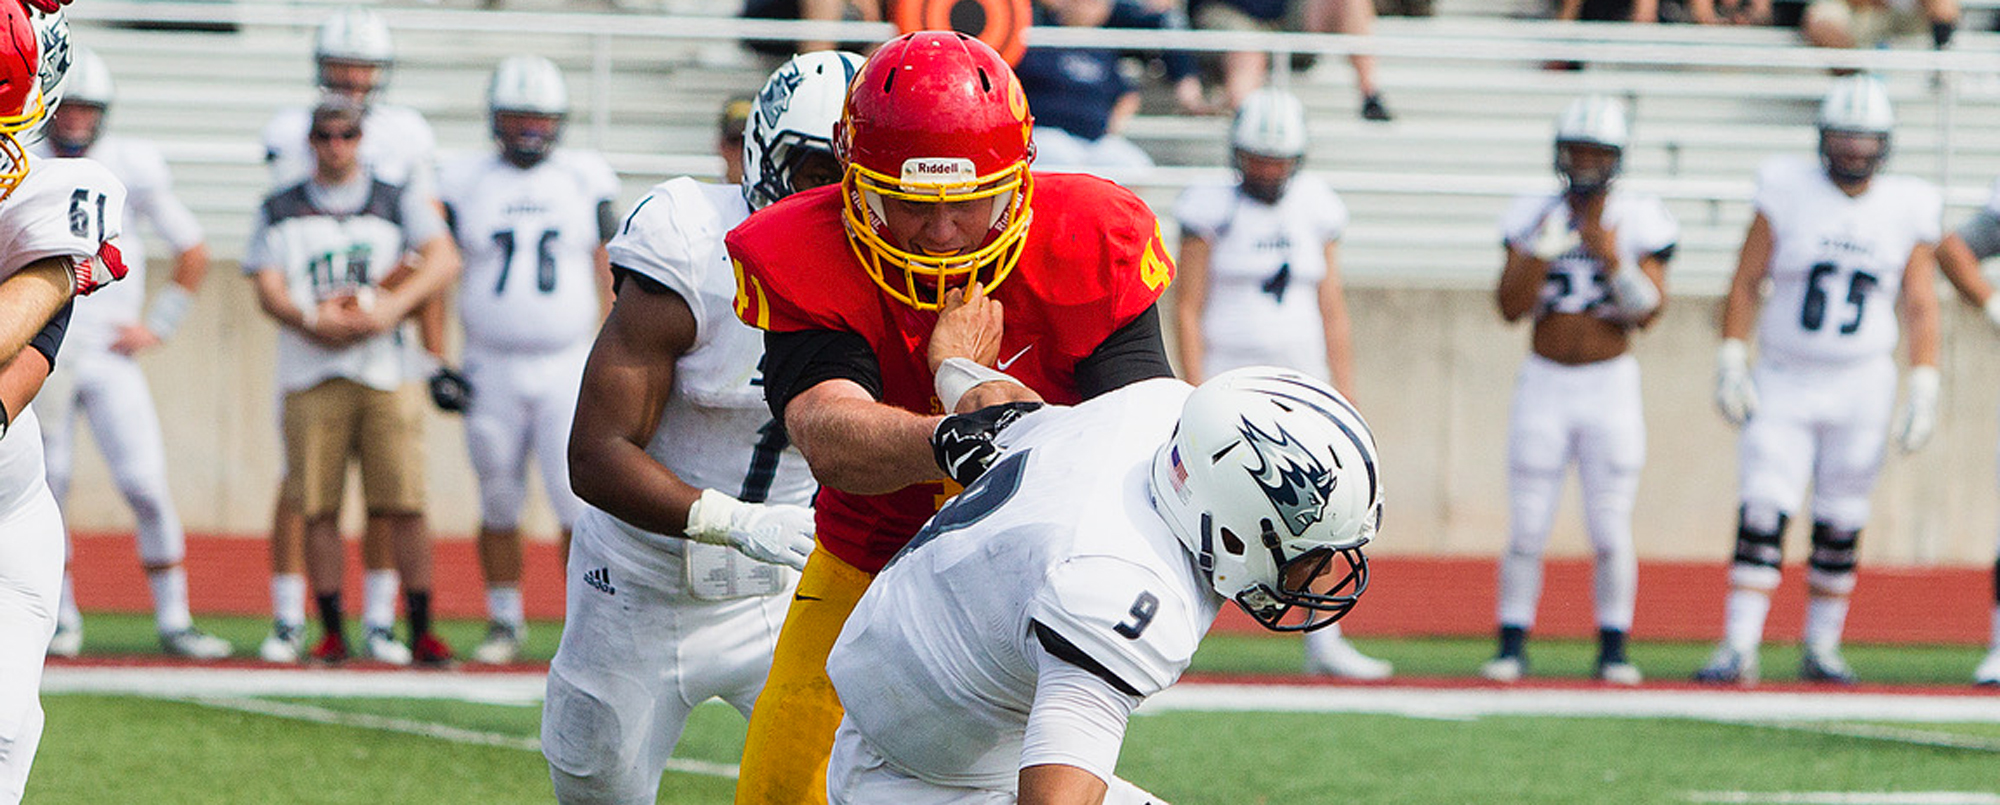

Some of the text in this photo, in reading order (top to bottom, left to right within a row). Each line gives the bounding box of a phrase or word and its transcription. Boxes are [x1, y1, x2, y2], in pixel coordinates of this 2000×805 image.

[918, 162, 959, 174] Riddell
[69, 187, 107, 244] 61
[491, 228, 559, 297] 76
[1262, 261, 1290, 305] 4
[1802, 260, 1878, 335] 65
[1112, 589, 1160, 641] 9
